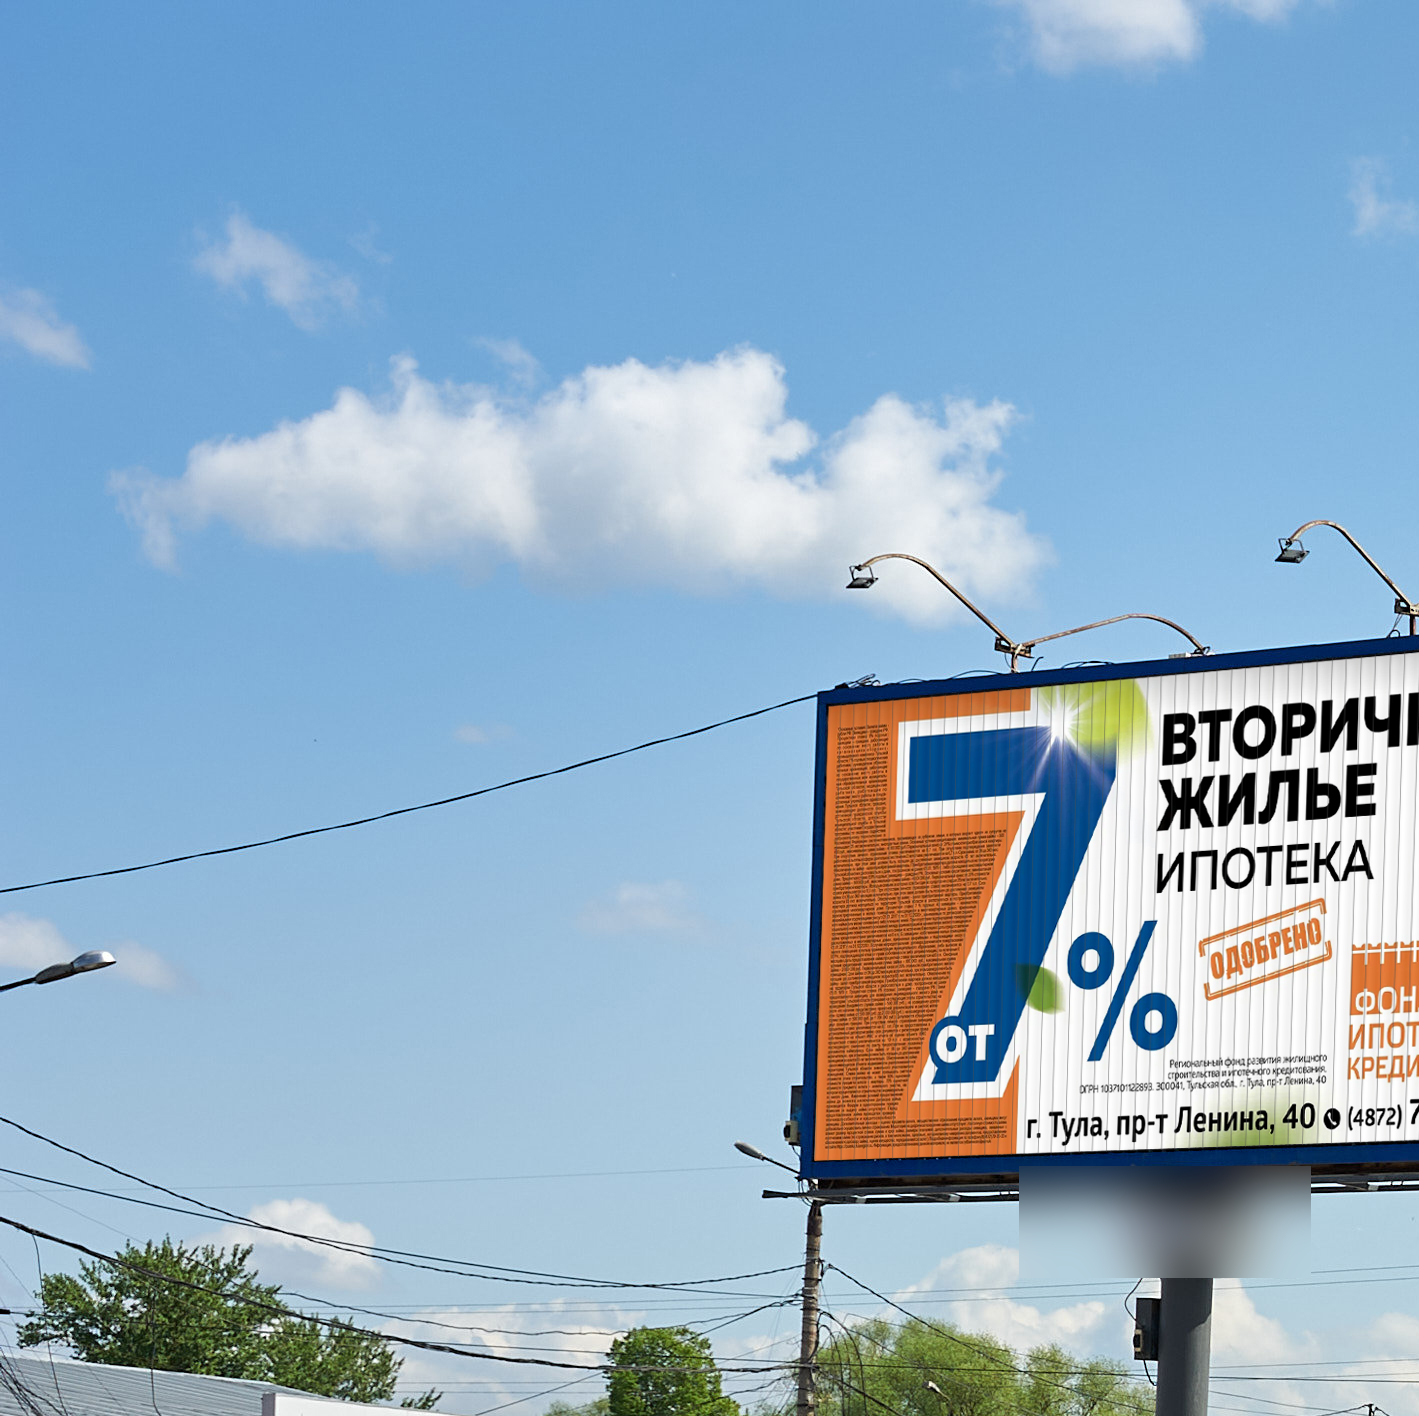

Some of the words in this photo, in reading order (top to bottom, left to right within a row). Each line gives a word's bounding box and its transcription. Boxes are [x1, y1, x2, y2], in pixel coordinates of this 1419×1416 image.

[1156, 762, 1377, 832] ЖИЛЬЕ
[1156, 839, 1374, 893] ИПОТЕКА
[1210, 917, 1322, 980] ОДОБРЕНО
[1168, 1068, 1220, 1081] строительства
[1187, 1080, 1219, 1092] Тульская
[1316, 1075, 1327, 1085] 40
[1224, 1057, 1246, 1069] фонд
[1246, 1056, 1282, 1067] развития
[1027, 1117, 1041, 1139] г.
[1049, 1111, 1109, 1146] Тула,
[1117, 1112, 1168, 1142] пр-т
[1174, 1106, 1275, 1134] Ленина,
[1283, 1102, 1315, 1129] 40
[1348, 1104, 1402, 1130] (4872)
